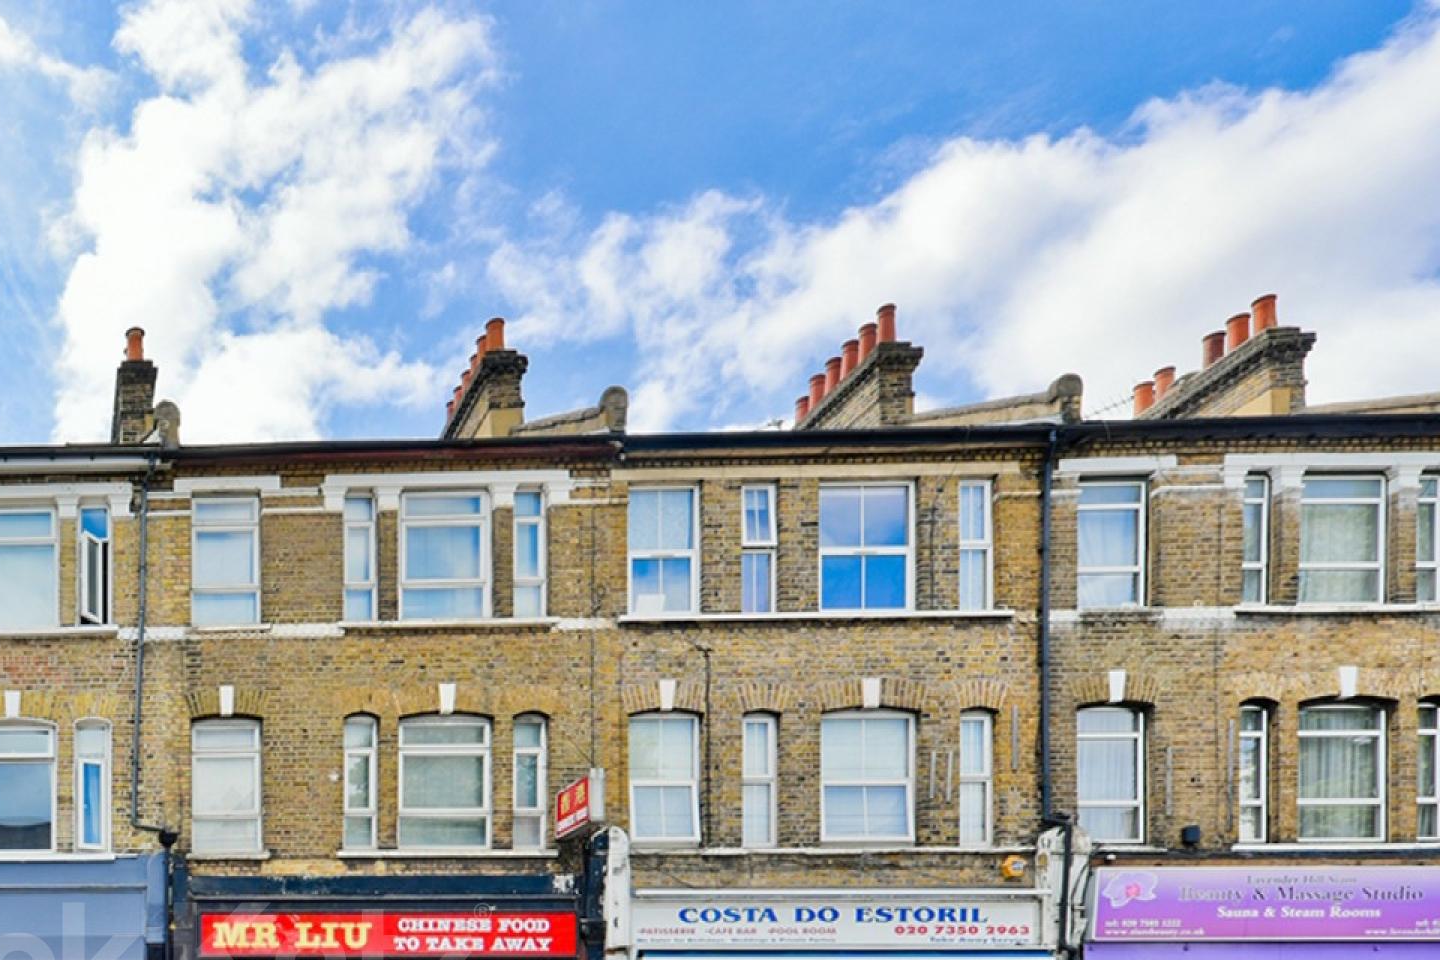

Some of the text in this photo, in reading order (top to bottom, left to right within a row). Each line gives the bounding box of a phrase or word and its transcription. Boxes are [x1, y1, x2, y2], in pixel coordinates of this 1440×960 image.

[1180, 885, 1424, 904] Beauty & Massage Studio
[678, 906, 988, 924] COSTA DO ESTORIL
[1216, 904, 1381, 919] Sauna & Steam Rooms
[397, 917, 551, 934] CHINESE FOOD
[894, 926, 928, 935] 020
[212, 922, 373, 949] MR LIU
[392, 936, 553, 952] TO TAKE AWAY
